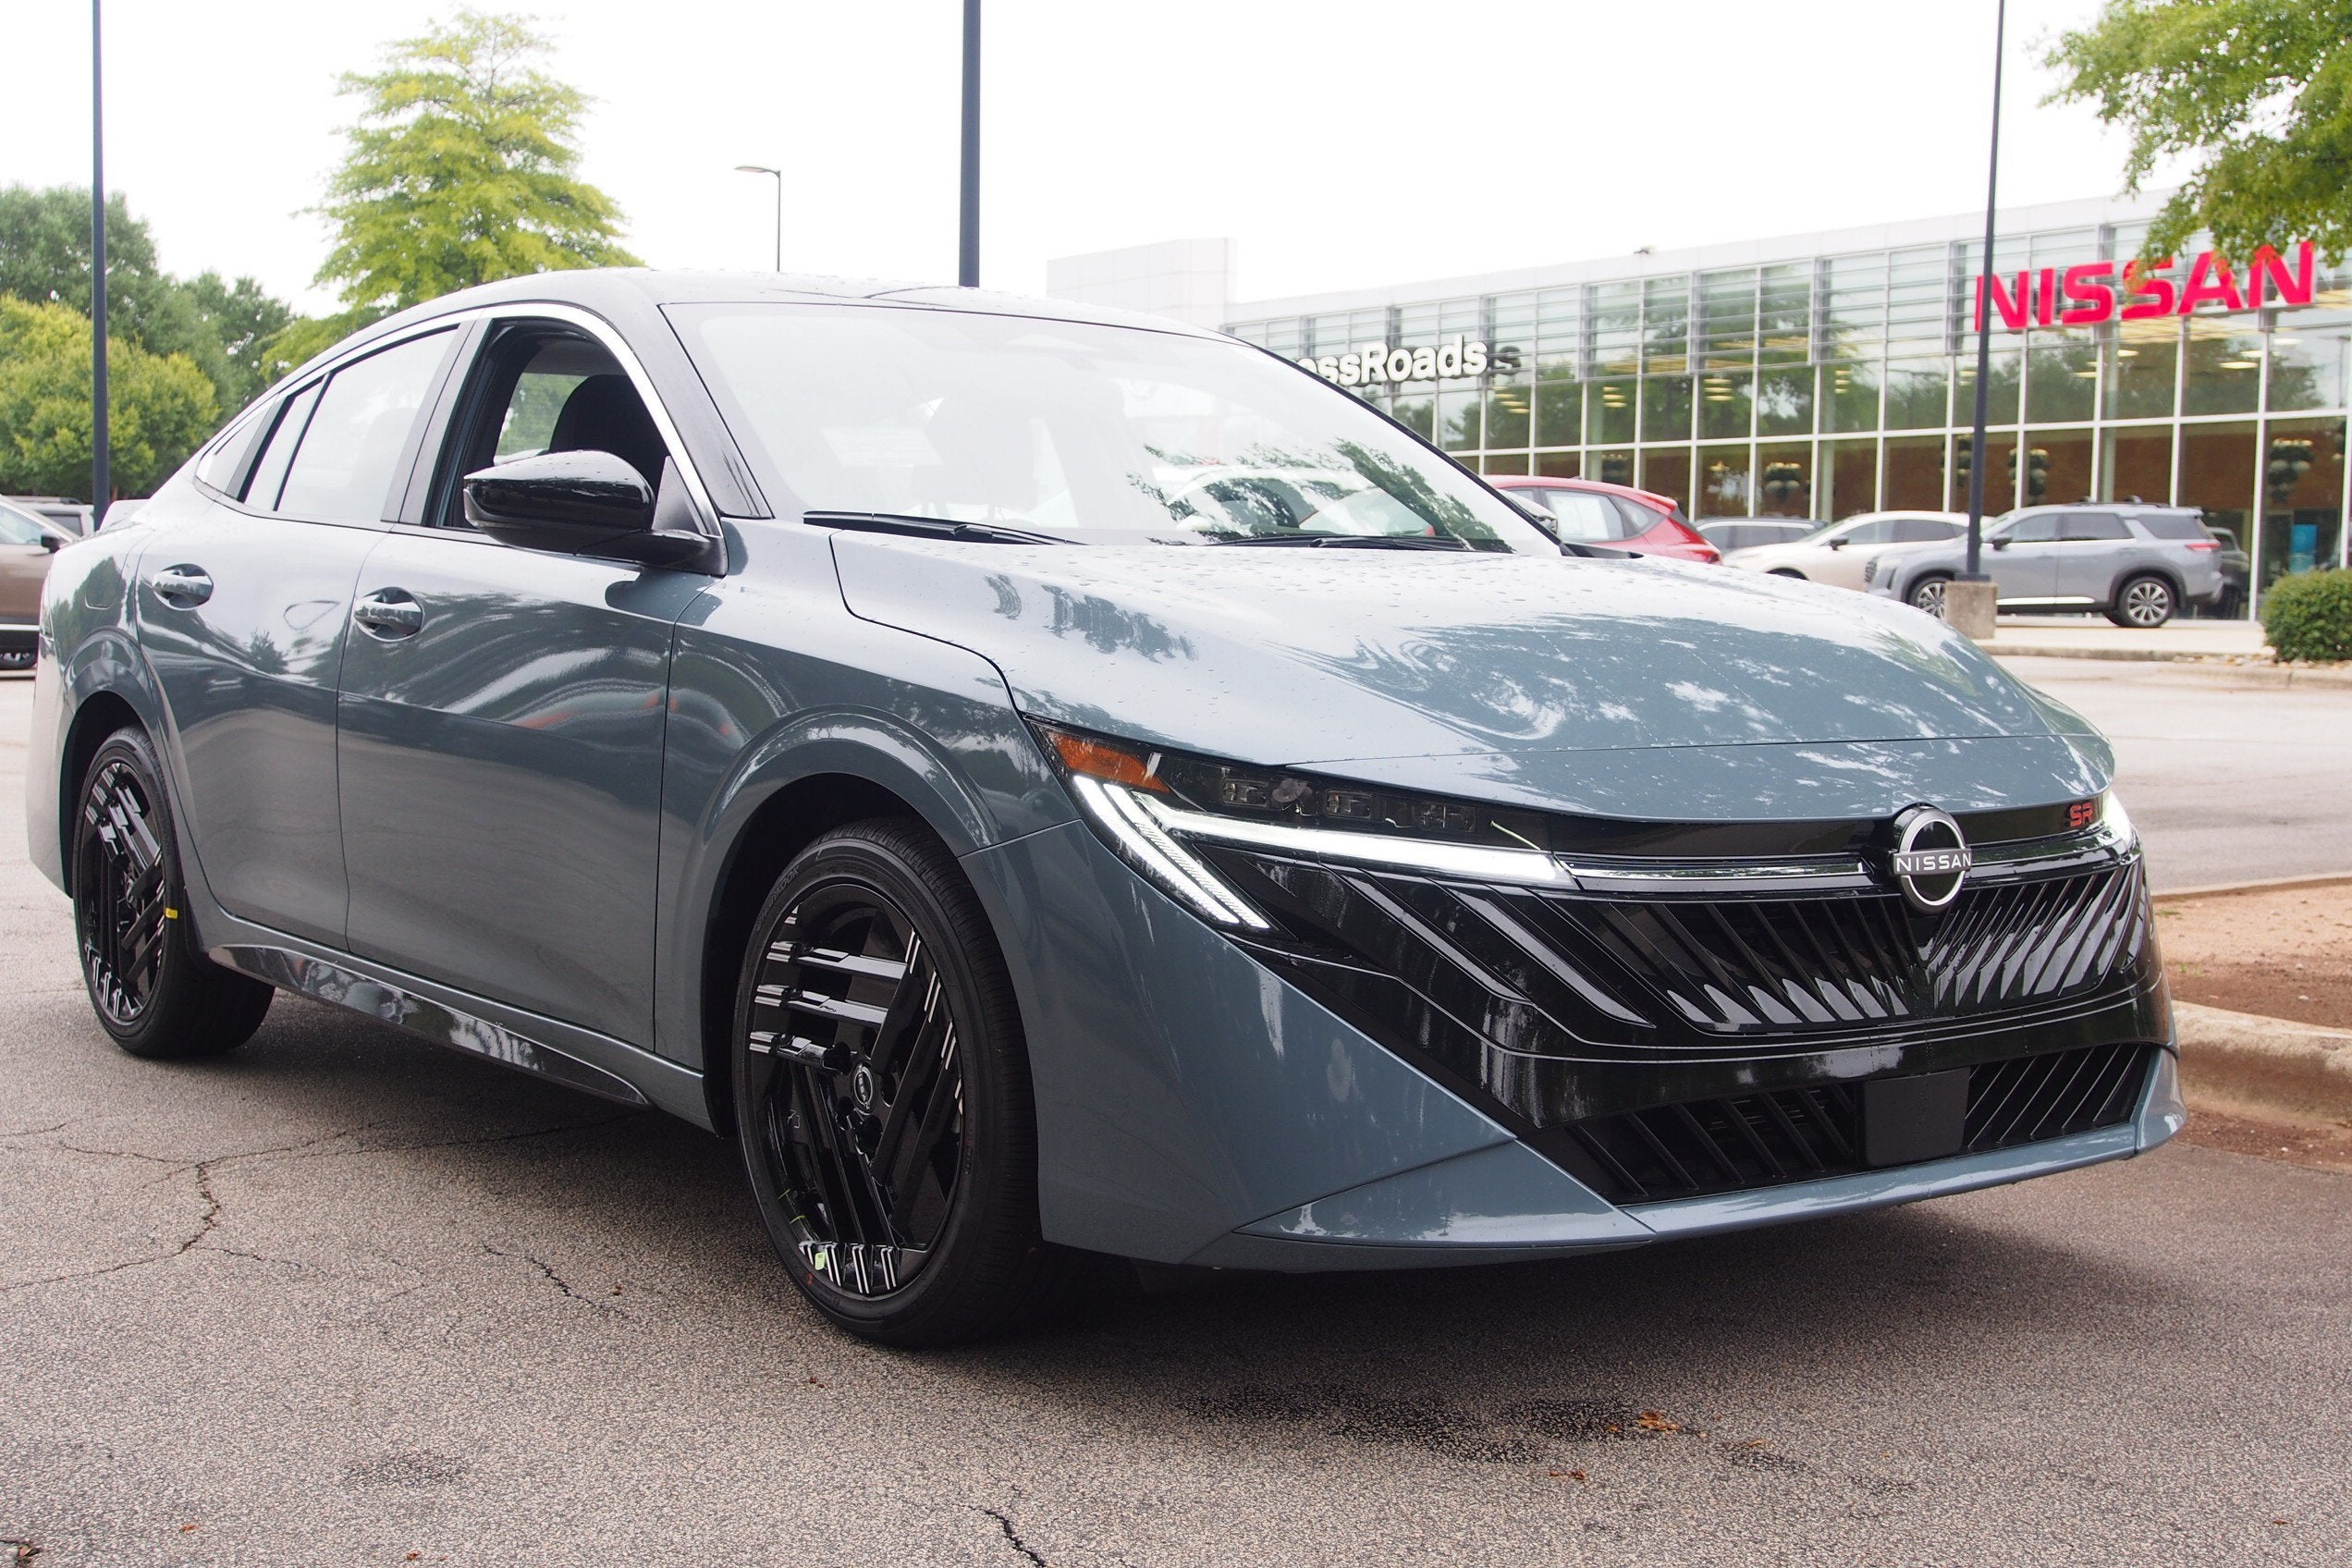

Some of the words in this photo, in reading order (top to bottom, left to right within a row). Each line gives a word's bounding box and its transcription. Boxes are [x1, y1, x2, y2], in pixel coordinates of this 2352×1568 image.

[1975, 241, 2314, 331] NISSAN
[2070, 802, 2093, 827] SR
[1896, 852, 1971, 872] NISSAN
